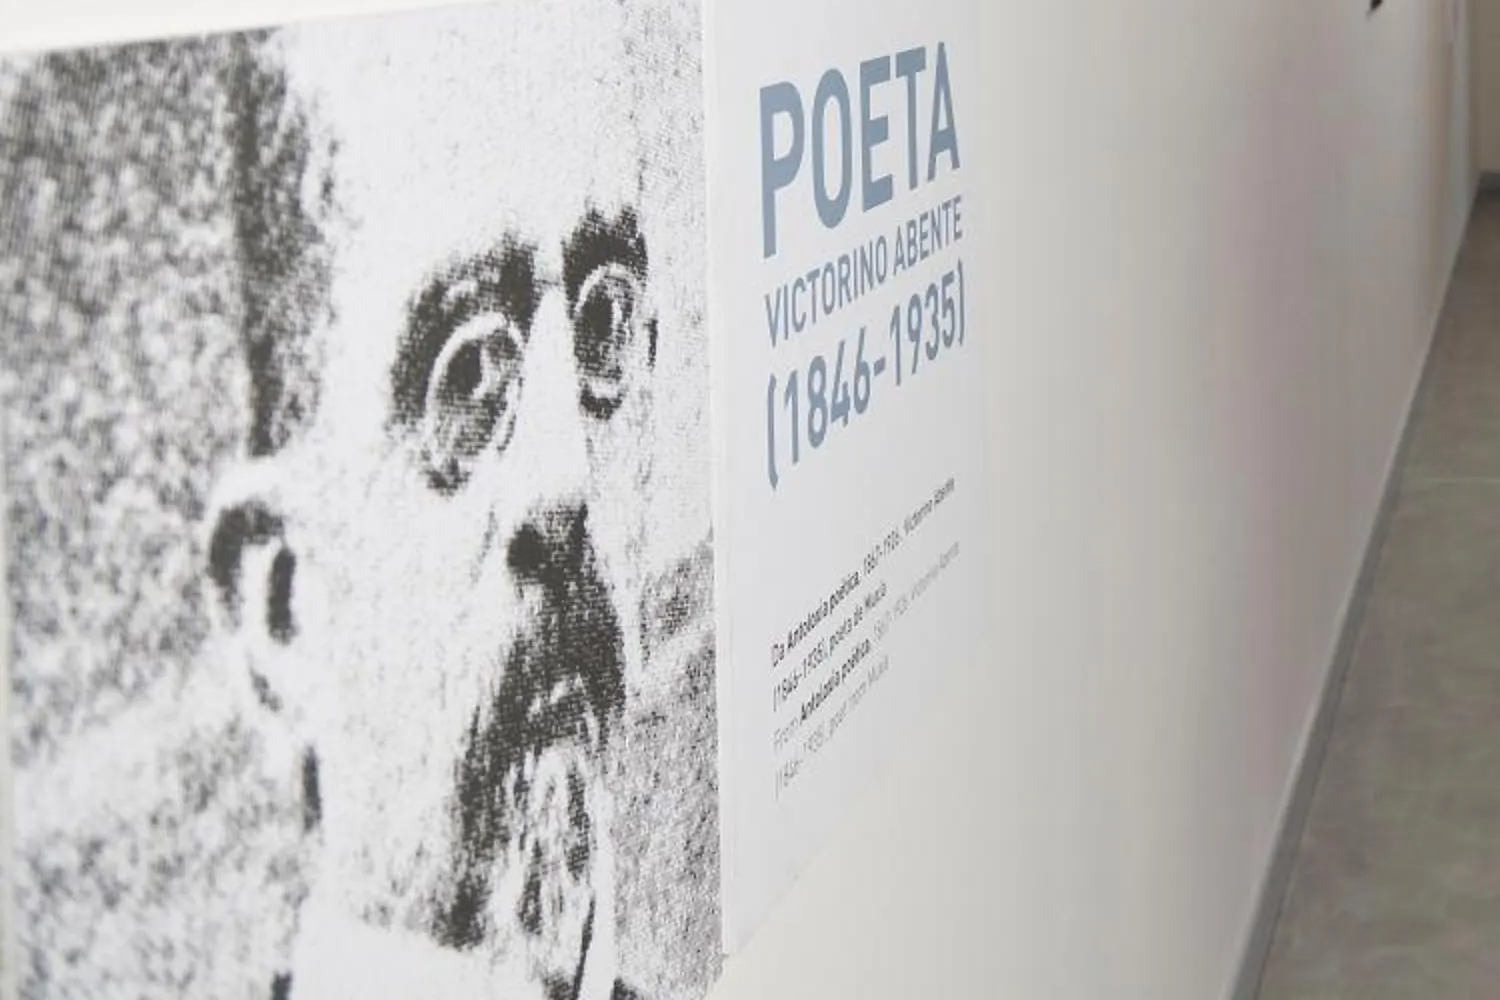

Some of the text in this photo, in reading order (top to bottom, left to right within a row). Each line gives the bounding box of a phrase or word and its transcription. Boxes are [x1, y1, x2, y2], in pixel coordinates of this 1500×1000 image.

[759, 41, 960, 259] POETA
[765, 195, 962, 348] VICTORINO ABENTE
[767, 258, 965, 490] (1846-1935)
